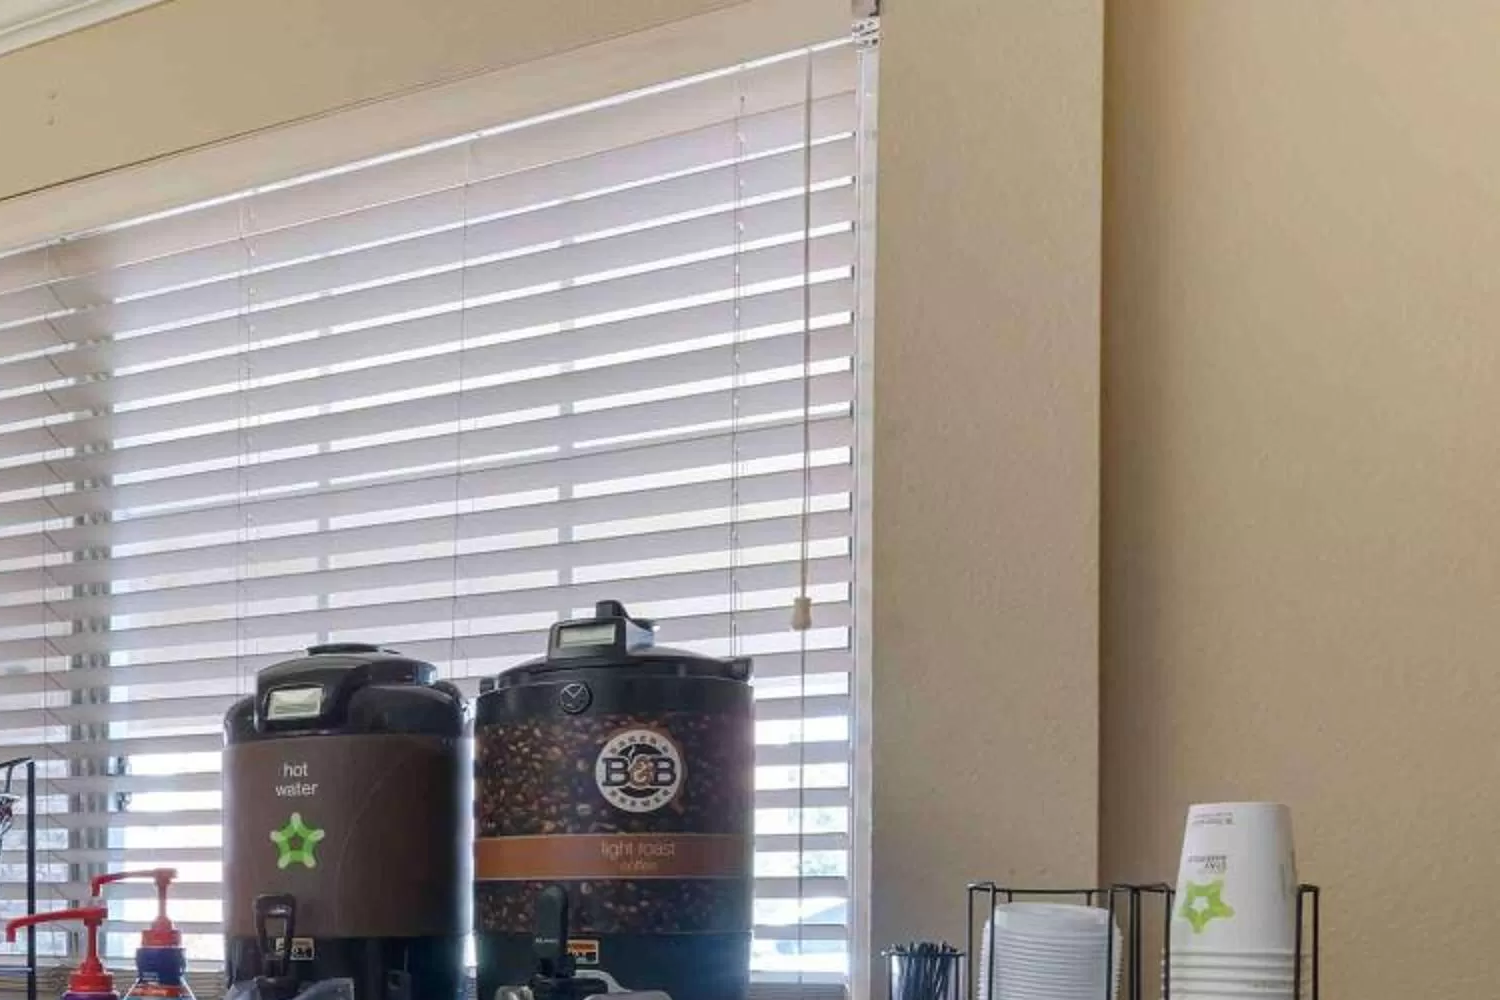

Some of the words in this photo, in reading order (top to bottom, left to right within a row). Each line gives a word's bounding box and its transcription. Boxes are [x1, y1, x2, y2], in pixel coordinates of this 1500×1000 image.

[283, 761, 309, 778] hot
[275, 782, 320, 797] water
[601, 840, 634, 861] light
[638, 841, 675, 857] roast
